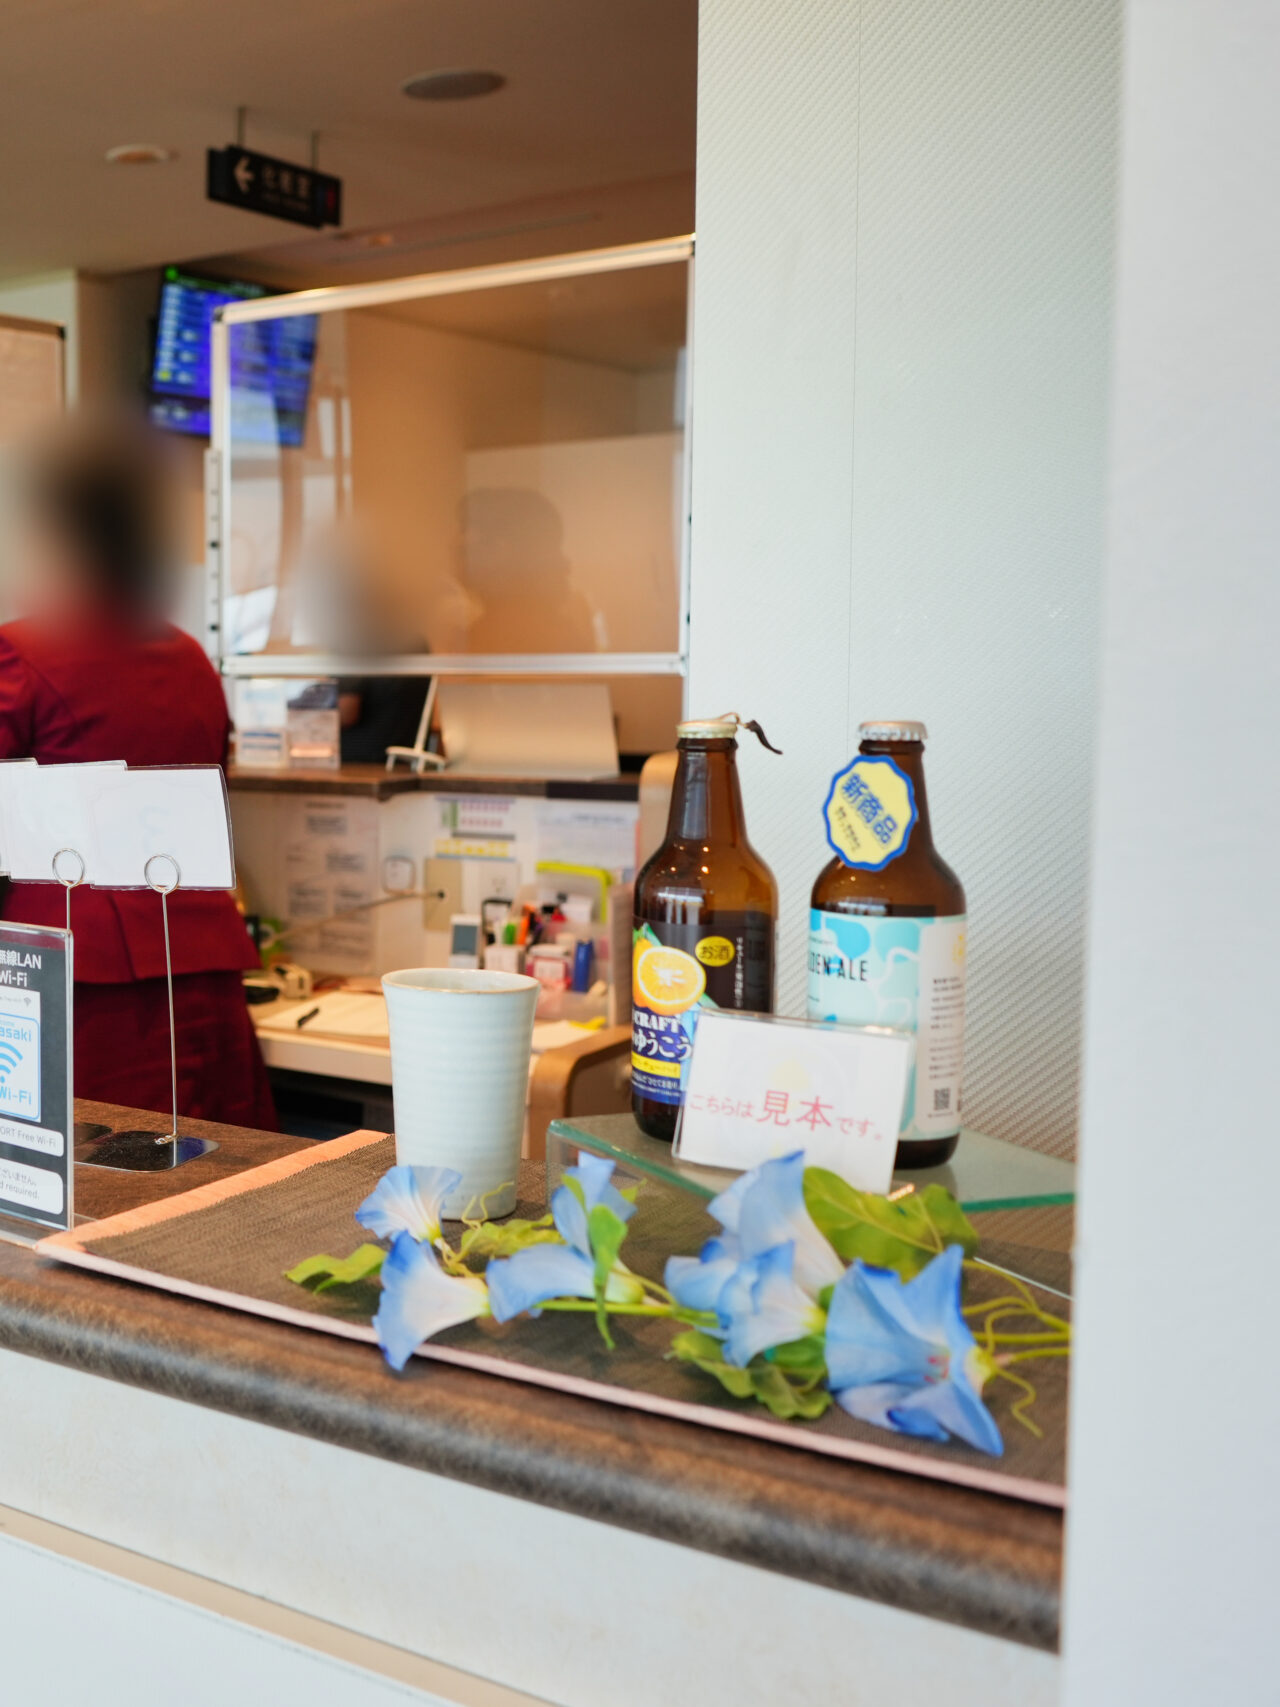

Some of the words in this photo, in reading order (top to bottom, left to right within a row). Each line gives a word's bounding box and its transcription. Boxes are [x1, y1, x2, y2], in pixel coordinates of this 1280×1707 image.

[842, 773, 898, 844] 新商品
[700, 944, 730, 961] お酒
[837, 958, 869, 981] ALE
[634, 1011, 681, 1033] CRAFT
[690, 1090, 883, 1141] こちらは見本です。
[17, 1130, 35, 1143] Free
[36, 1135, 57, 1148] Wi-Fi
[5, 1183, 40, 1200] required.
